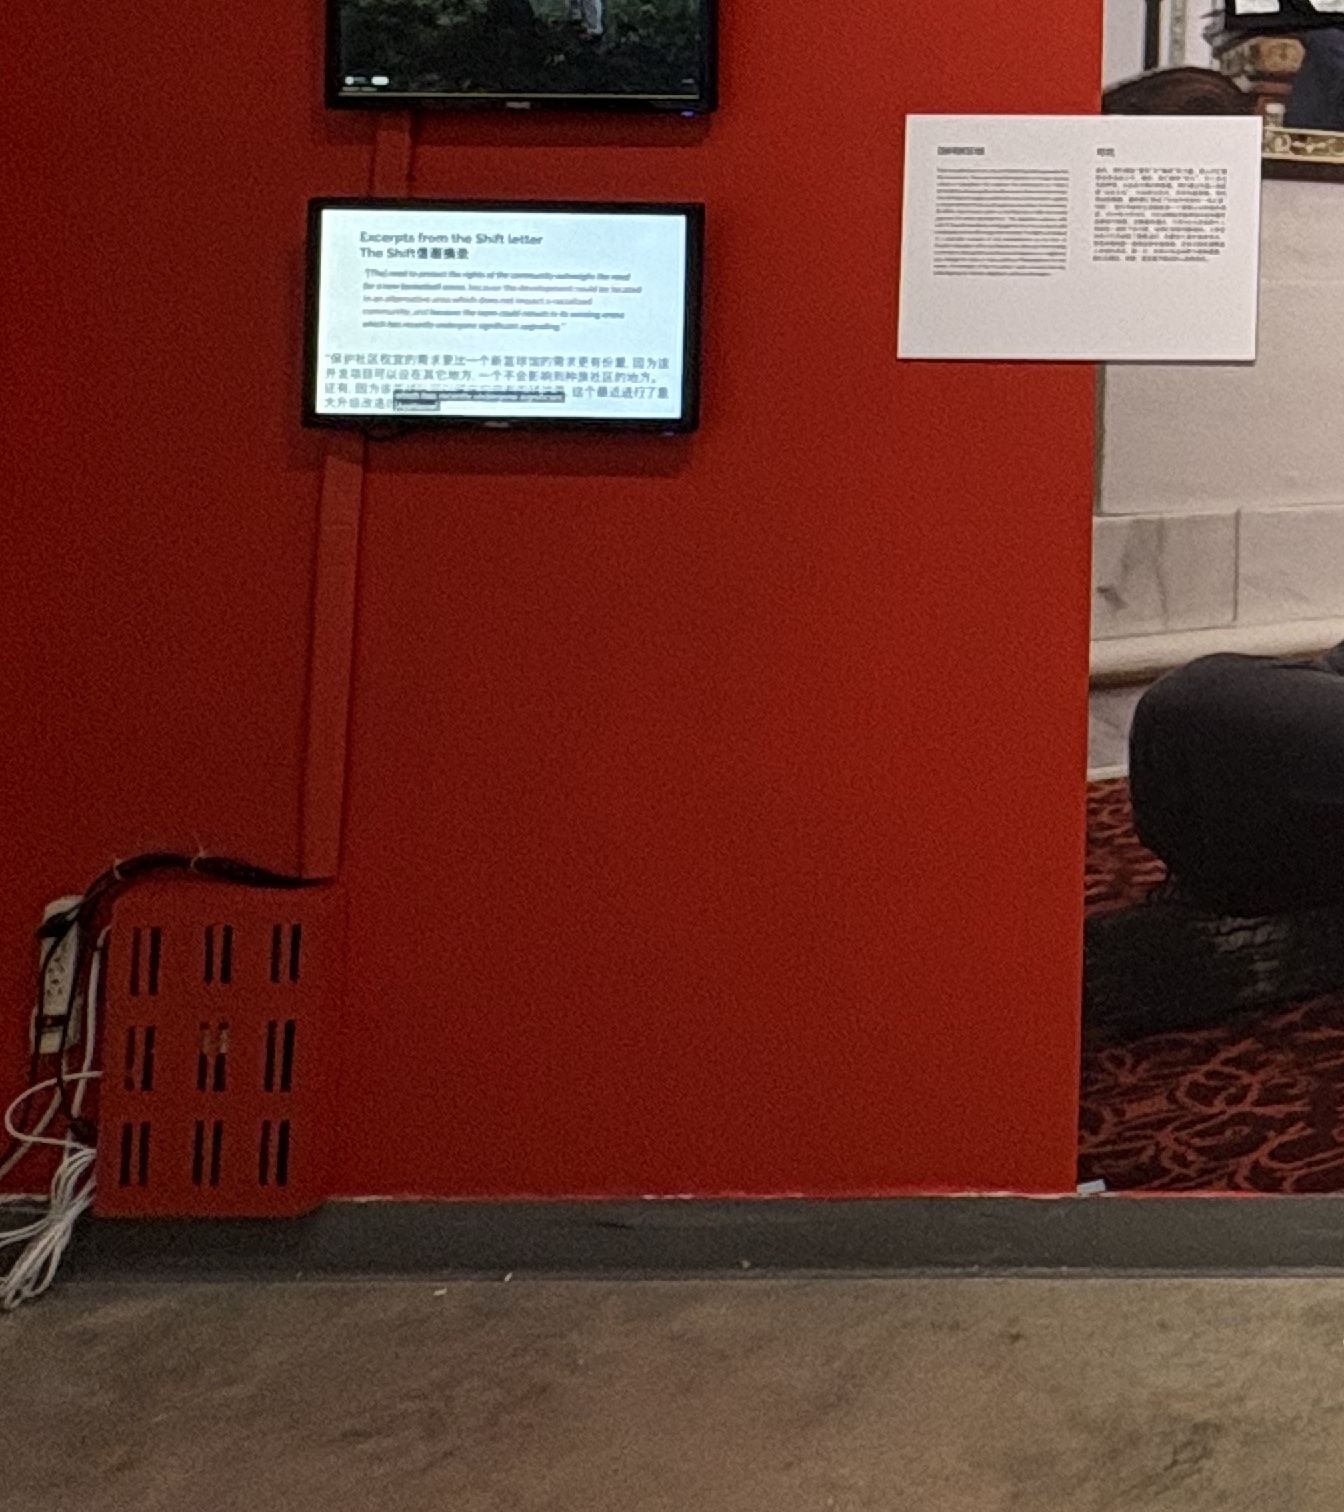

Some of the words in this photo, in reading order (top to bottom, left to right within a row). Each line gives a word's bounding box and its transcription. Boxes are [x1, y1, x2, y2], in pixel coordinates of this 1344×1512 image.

[419, 232, 448, 244] from
[451, 233, 472, 244] the
[476, 233, 504, 245] Shift
[507, 234, 543, 245] letter
[360, 247, 383, 258] The
